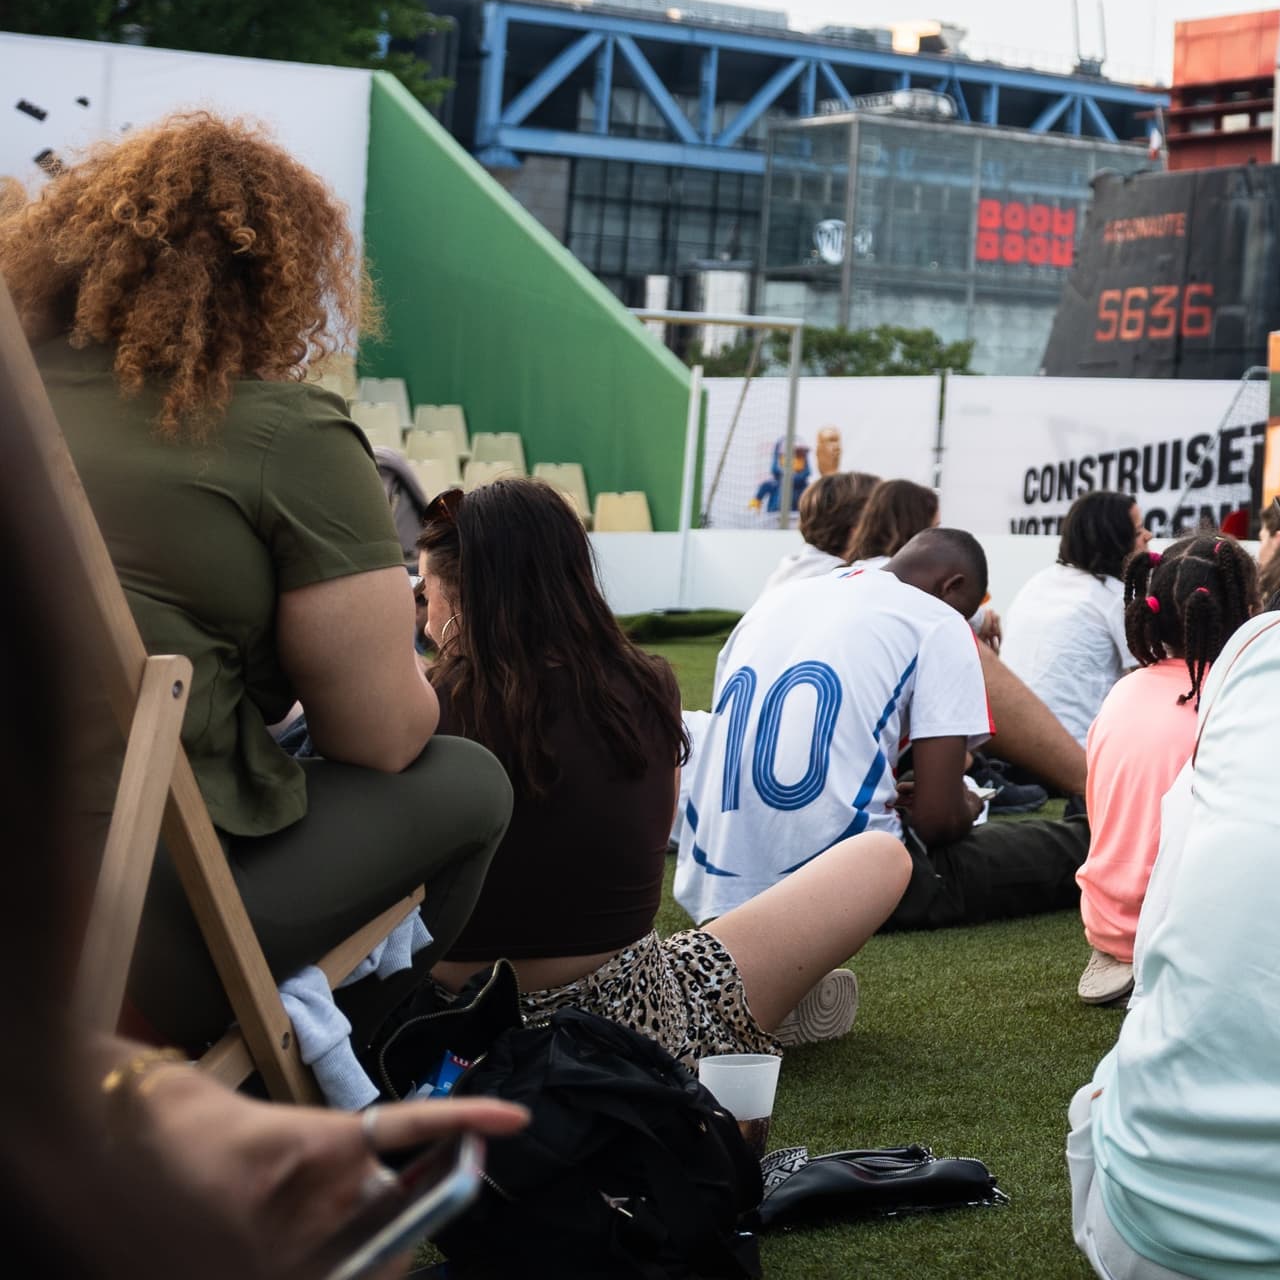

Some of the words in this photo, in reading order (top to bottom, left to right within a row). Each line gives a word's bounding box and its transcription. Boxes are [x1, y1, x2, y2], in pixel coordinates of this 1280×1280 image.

[977, 199, 1076, 236] BOOM
[975, 231, 1074, 267] BOOM
[715, 660, 843, 813] 10
